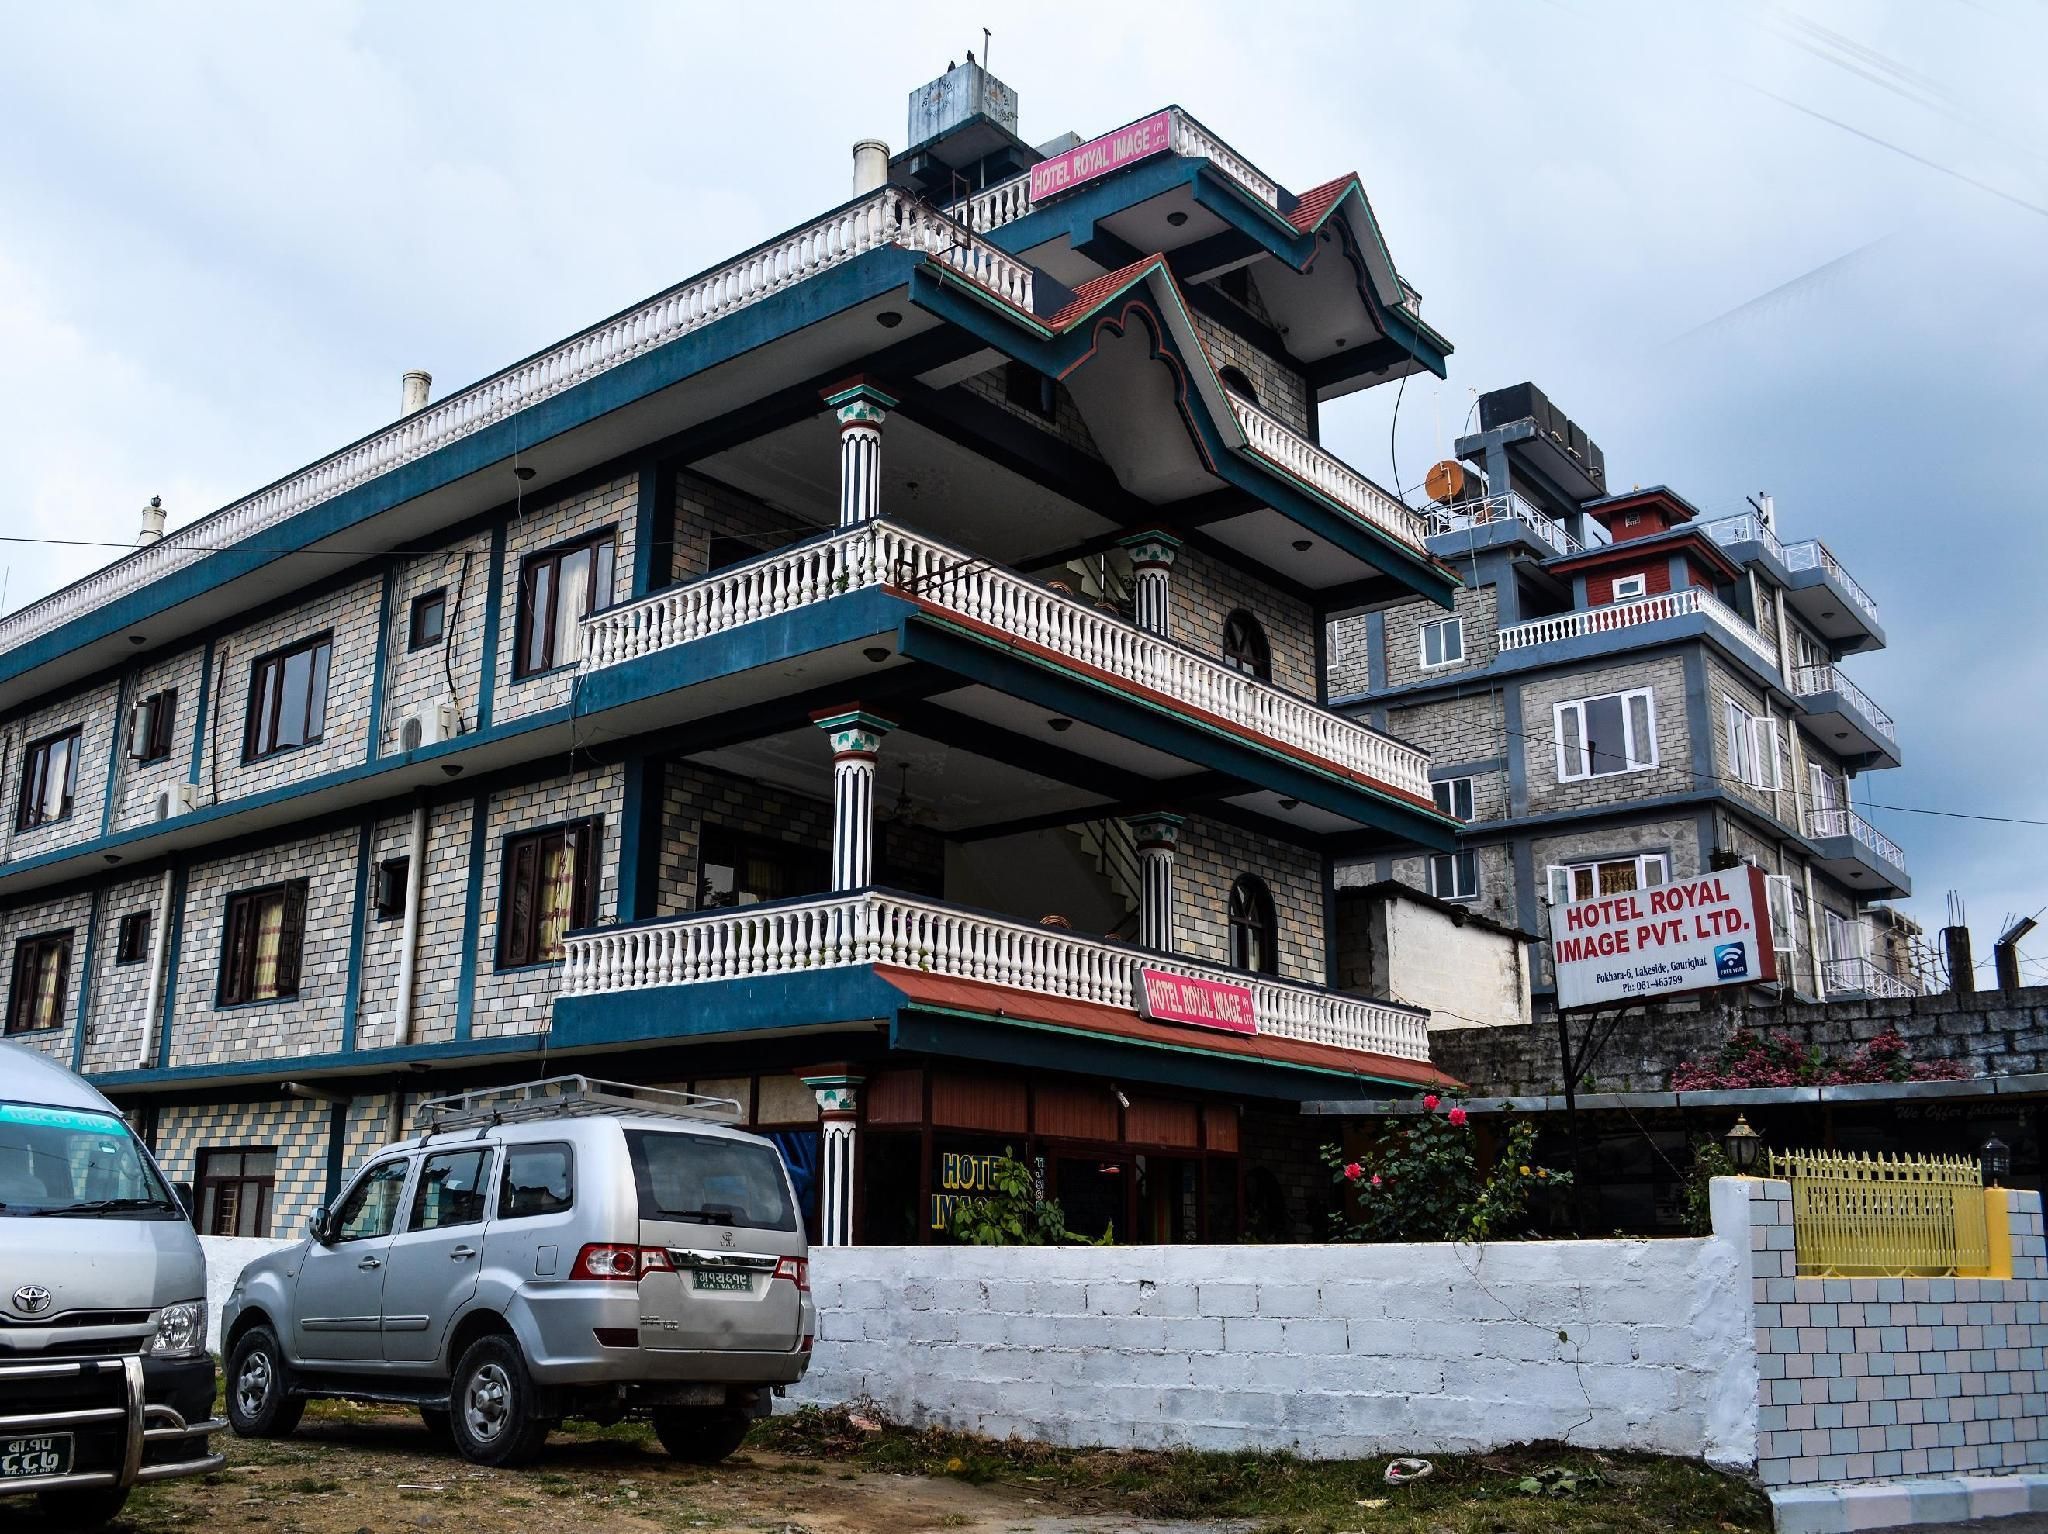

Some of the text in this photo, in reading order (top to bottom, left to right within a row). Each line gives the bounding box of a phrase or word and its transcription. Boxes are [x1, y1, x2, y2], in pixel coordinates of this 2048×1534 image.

[1035, 162, 1070, 195] HOTEL
[1073, 147, 1109, 178] ROYAL
[1112, 126, 1150, 163] IMAGE
[1567, 879, 1730, 931] HOTEL ROYAL
[1556, 908, 1750, 964] IMAGE PVT. LTD.
[1148, 979, 1183, 1013] HOTEL
[1181, 985, 1213, 1019] ROYAL
[1213, 991, 1242, 1024] IMAGE
[943, 1152, 1003, 1191] HOTE
